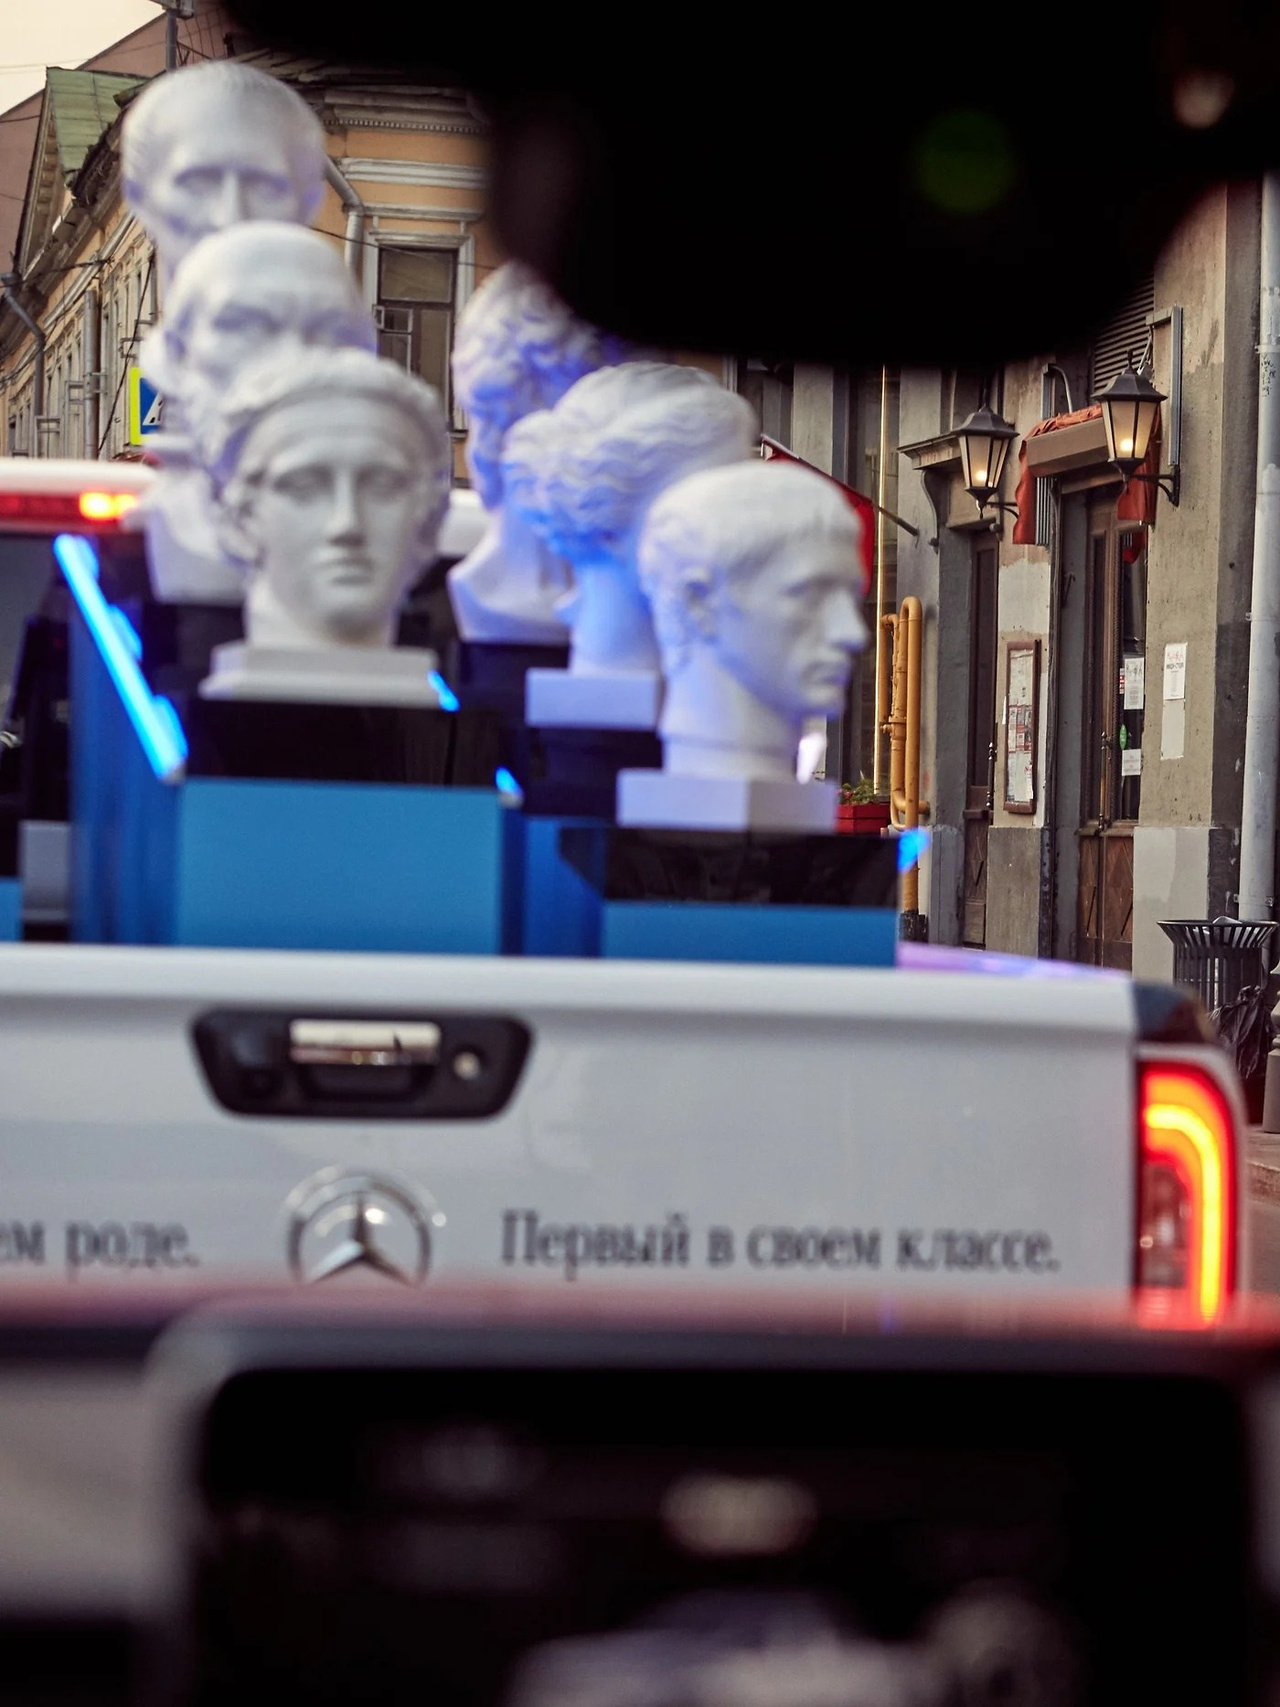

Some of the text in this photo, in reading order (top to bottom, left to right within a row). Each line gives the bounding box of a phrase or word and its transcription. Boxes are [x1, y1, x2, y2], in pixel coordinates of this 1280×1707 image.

[501, 1208, 1061, 1282] Первый в своем классе.
